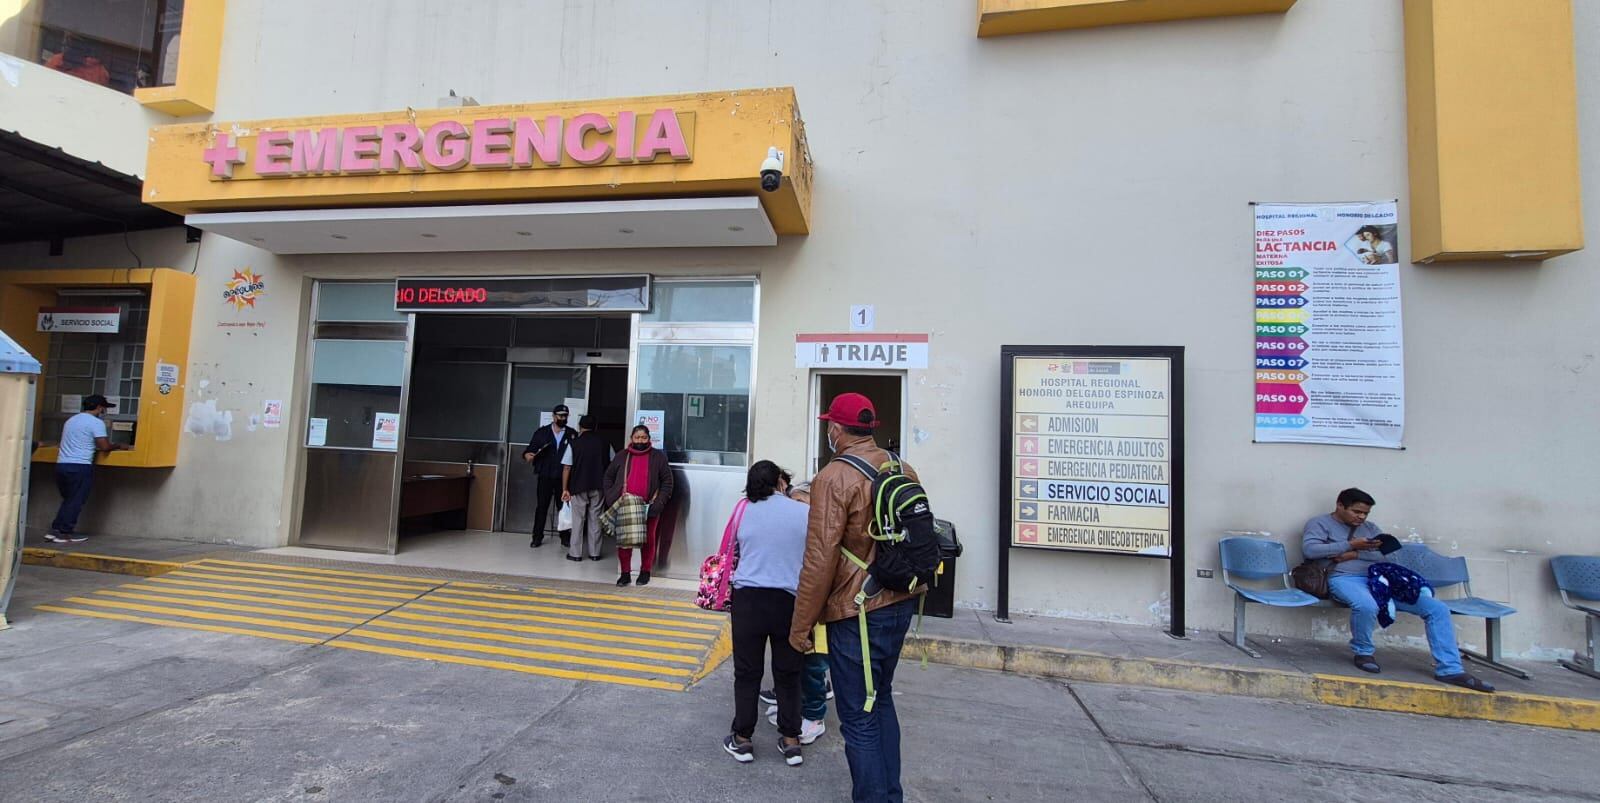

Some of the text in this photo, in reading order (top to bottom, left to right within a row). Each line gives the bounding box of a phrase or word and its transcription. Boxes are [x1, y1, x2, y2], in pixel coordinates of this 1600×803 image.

[254, 108, 691, 176] EMERGENCIA
[1256, 241, 1337, 252] LACTANCIA
[1256, 270, 1286, 278] PASO
[1288, 270, 1305, 278] 01
[1256, 284, 1286, 292] PASO
[1288, 284, 1305, 292] 02
[418, 287, 488, 303] DELGADO
[1256, 298, 1286, 306] PASO
[1288, 298, 1305, 306] 03
[858, 308, 866, 325] 1
[91, 319, 114, 327] SOCIAL
[1256, 325, 1286, 334] PASO
[1288, 325, 1305, 334] 05
[1256, 342, 1286, 350] PASO
[1288, 342, 1305, 350] 06
[835, 344, 908, 366] TRIAJE
[1256, 358, 1286, 366] PASO
[1288, 358, 1305, 366] 07
[1256, 372, 1286, 380] PASO
[1288, 372, 1305, 380] 08
[1040, 378, 1140, 388] HOSPITAL REGIONAL
[1019, 388, 1164, 400] HONORIO DELGADO ESPINOZA
[1256, 394, 1286, 402] PASO
[1288, 394, 1305, 402] 09
[1066, 400, 1114, 409] AREQUIPA
[1048, 416, 1099, 434] ADMISION
[1256, 416, 1287, 424] PASO
[1290, 416, 1305, 425] 10
[1048, 438, 1164, 458] EMERGENCIA ADULTOS
[1048, 460, 1164, 481] EMERGENCIA PEDIATRICA
[1048, 484, 1166, 504] SERVICIO SOCIAL
[1048, 505, 1100, 522] FARMACIA
[1048, 527, 1096, 545] EMERGENCIA
